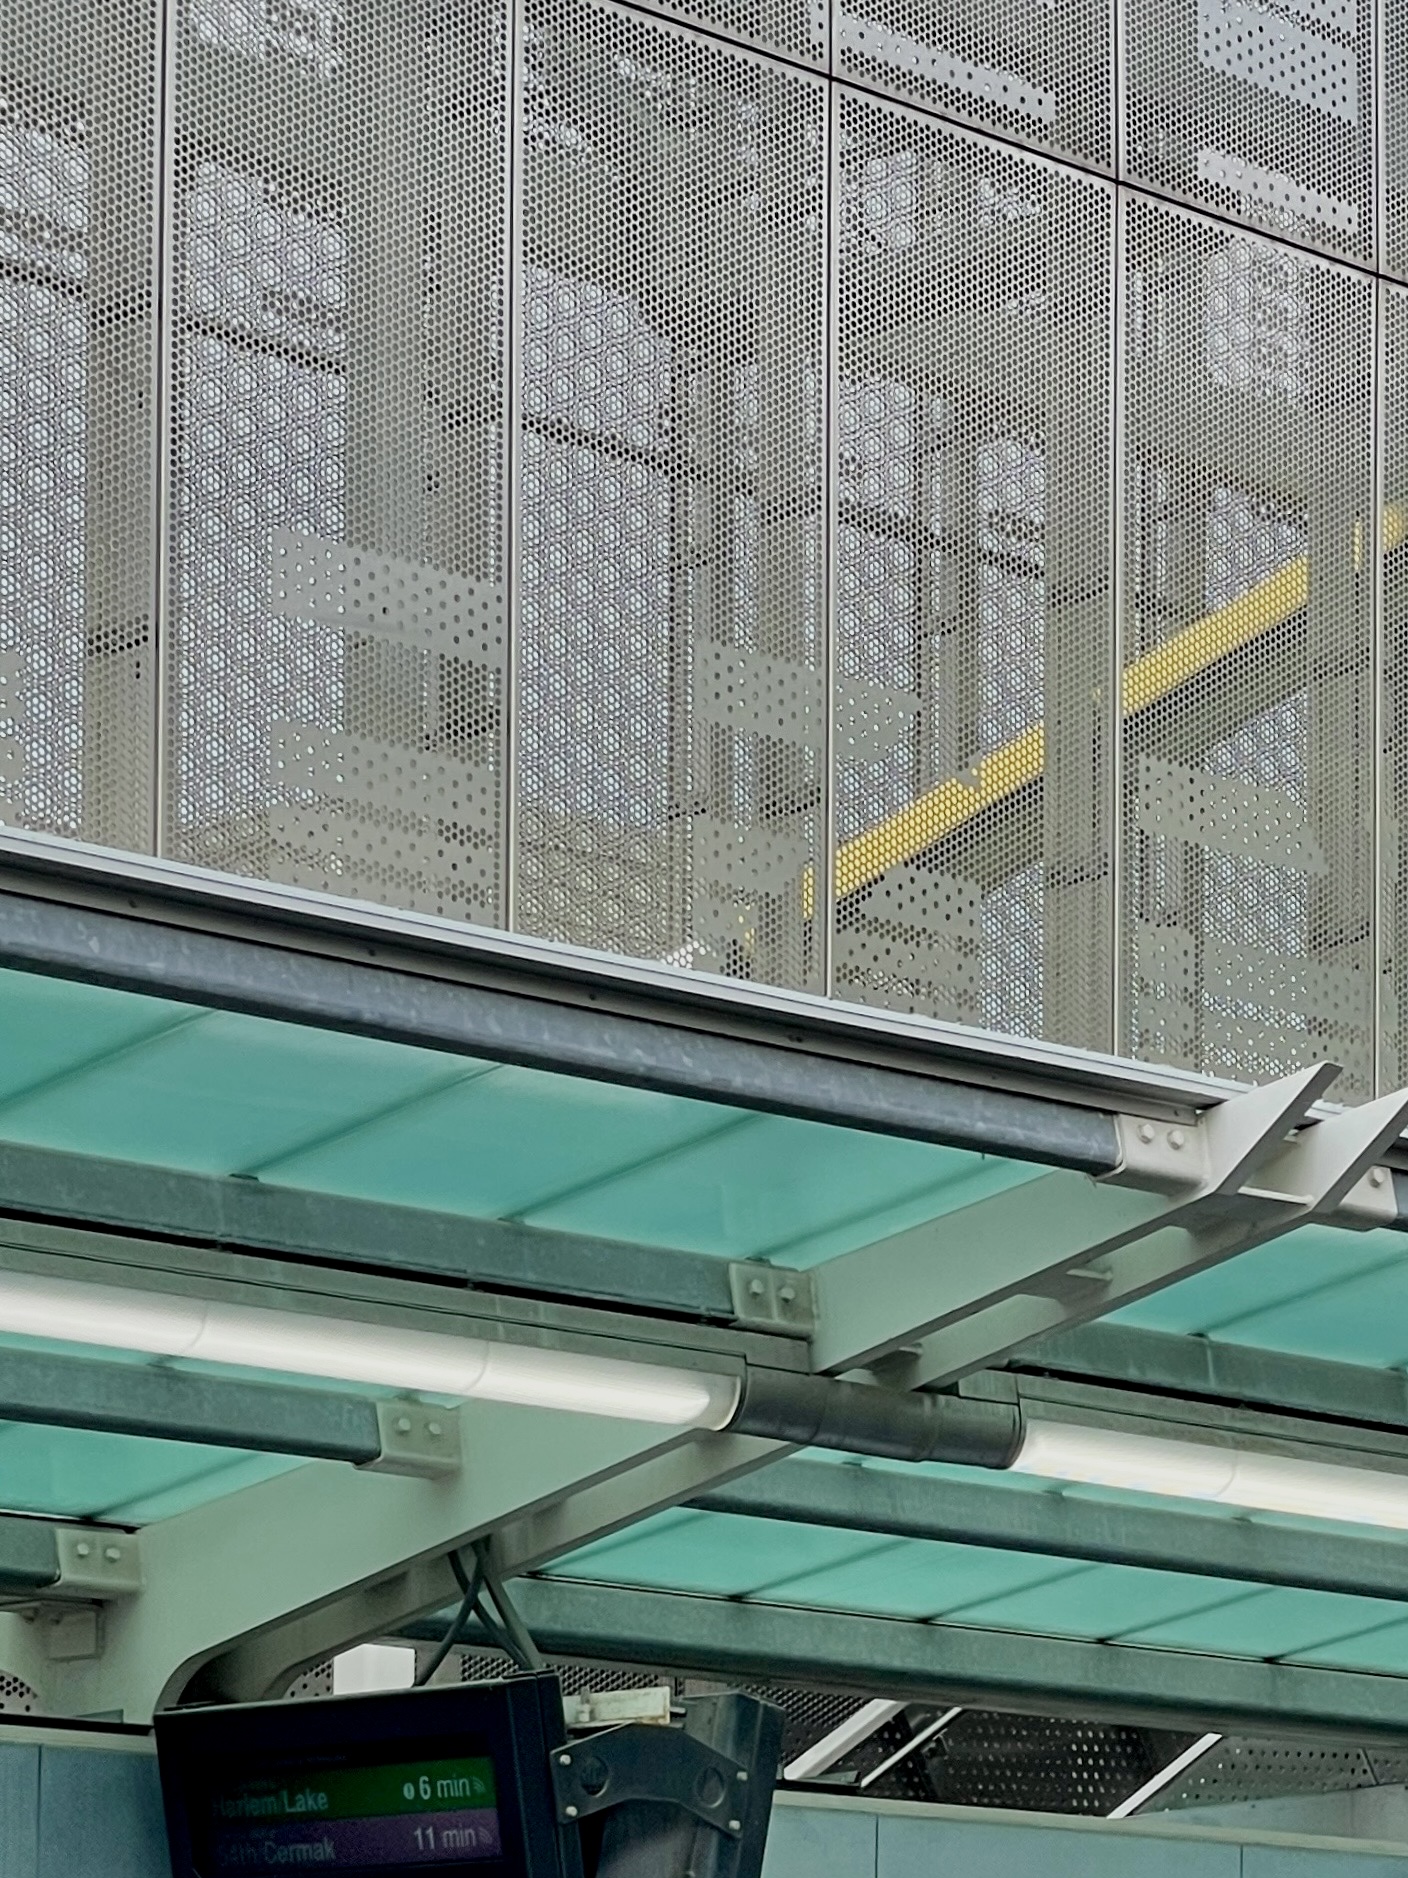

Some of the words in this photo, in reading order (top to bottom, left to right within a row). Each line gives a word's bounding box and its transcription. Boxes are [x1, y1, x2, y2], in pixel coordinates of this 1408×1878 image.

[418, 1776, 432, 1800] 6
[437, 1774, 472, 1800] min
[414, 1826, 436, 1851] 11
[441, 1824, 478, 1850] min
